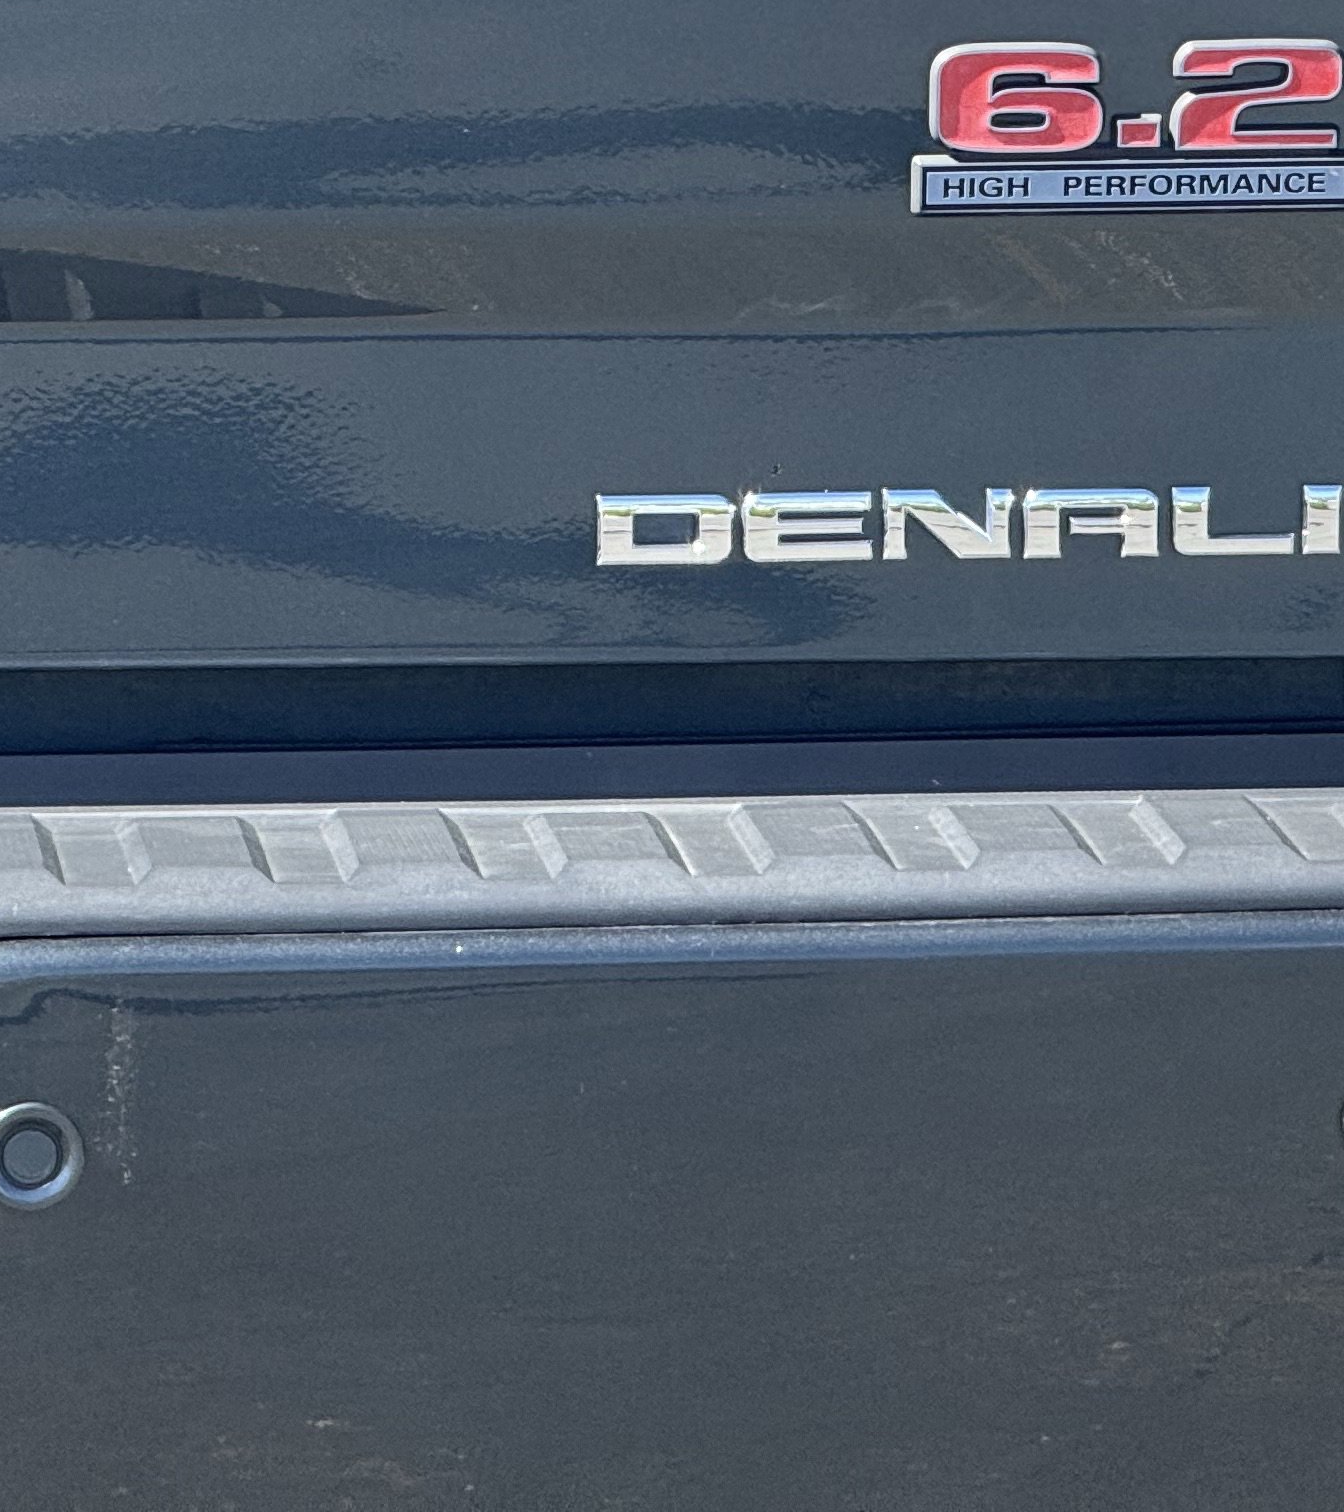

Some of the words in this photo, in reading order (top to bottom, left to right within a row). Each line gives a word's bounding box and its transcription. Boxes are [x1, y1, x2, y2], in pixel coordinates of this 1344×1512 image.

[929, 39, 1343, 153] 6.2
[943, 176, 1031, 198] HIGH
[1062, 172, 1326, 198] PERFORMANCE
[596, 485, 1342, 566] DENALI
